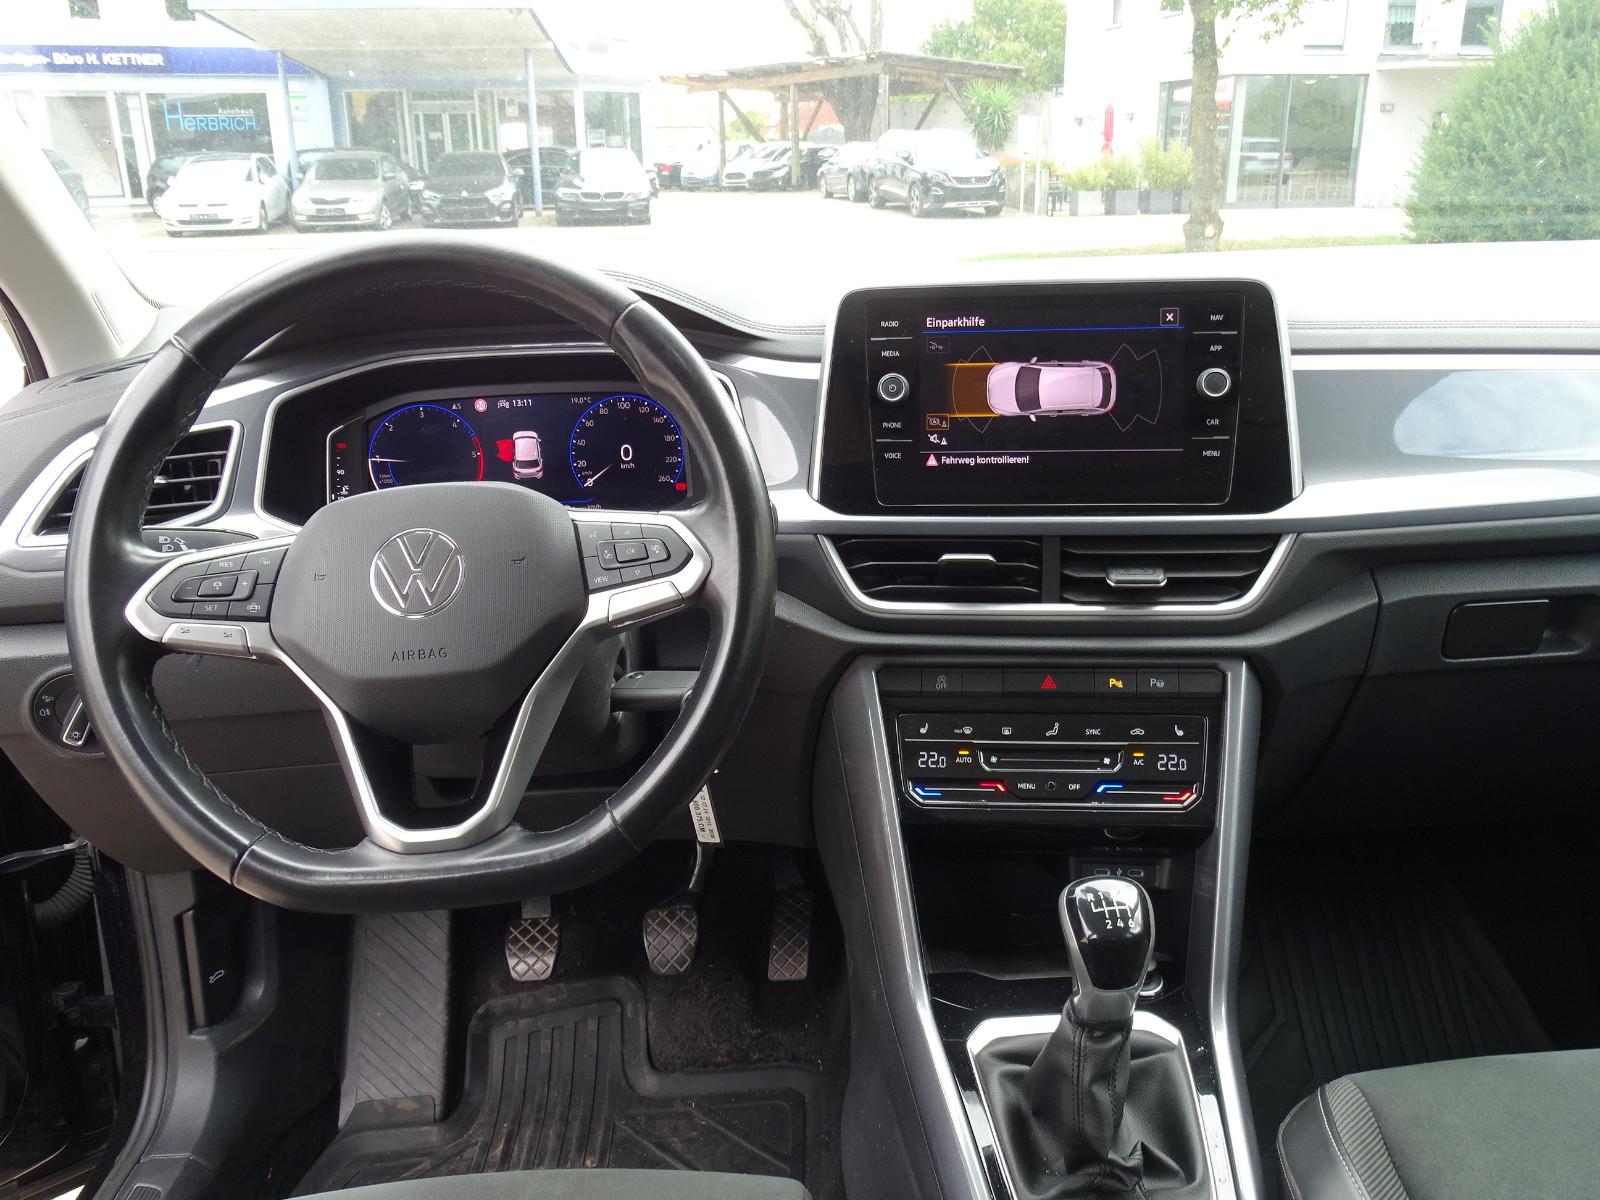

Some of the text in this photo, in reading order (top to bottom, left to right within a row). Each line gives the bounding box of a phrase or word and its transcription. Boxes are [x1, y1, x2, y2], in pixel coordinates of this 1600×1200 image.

[102, 53, 164, 66] KETTNER
[926, 316, 986, 329] Einparkhilfe
[512, 399, 532, 407] 13:11
[419, 410, 424, 418] 3
[620, 444, 633, 461] 0
[941, 454, 1030, 466] Fahrweg kontrollieren!
[594, 576, 609, 584] VIEW
[392, 647, 448, 662] AIRBAG
[918, 752, 946, 768] 22.0
[1157, 754, 1187, 771] 22.0
[1087, 892, 1104, 902] R 1
[1106, 918, 1135, 929] 2 4 6
